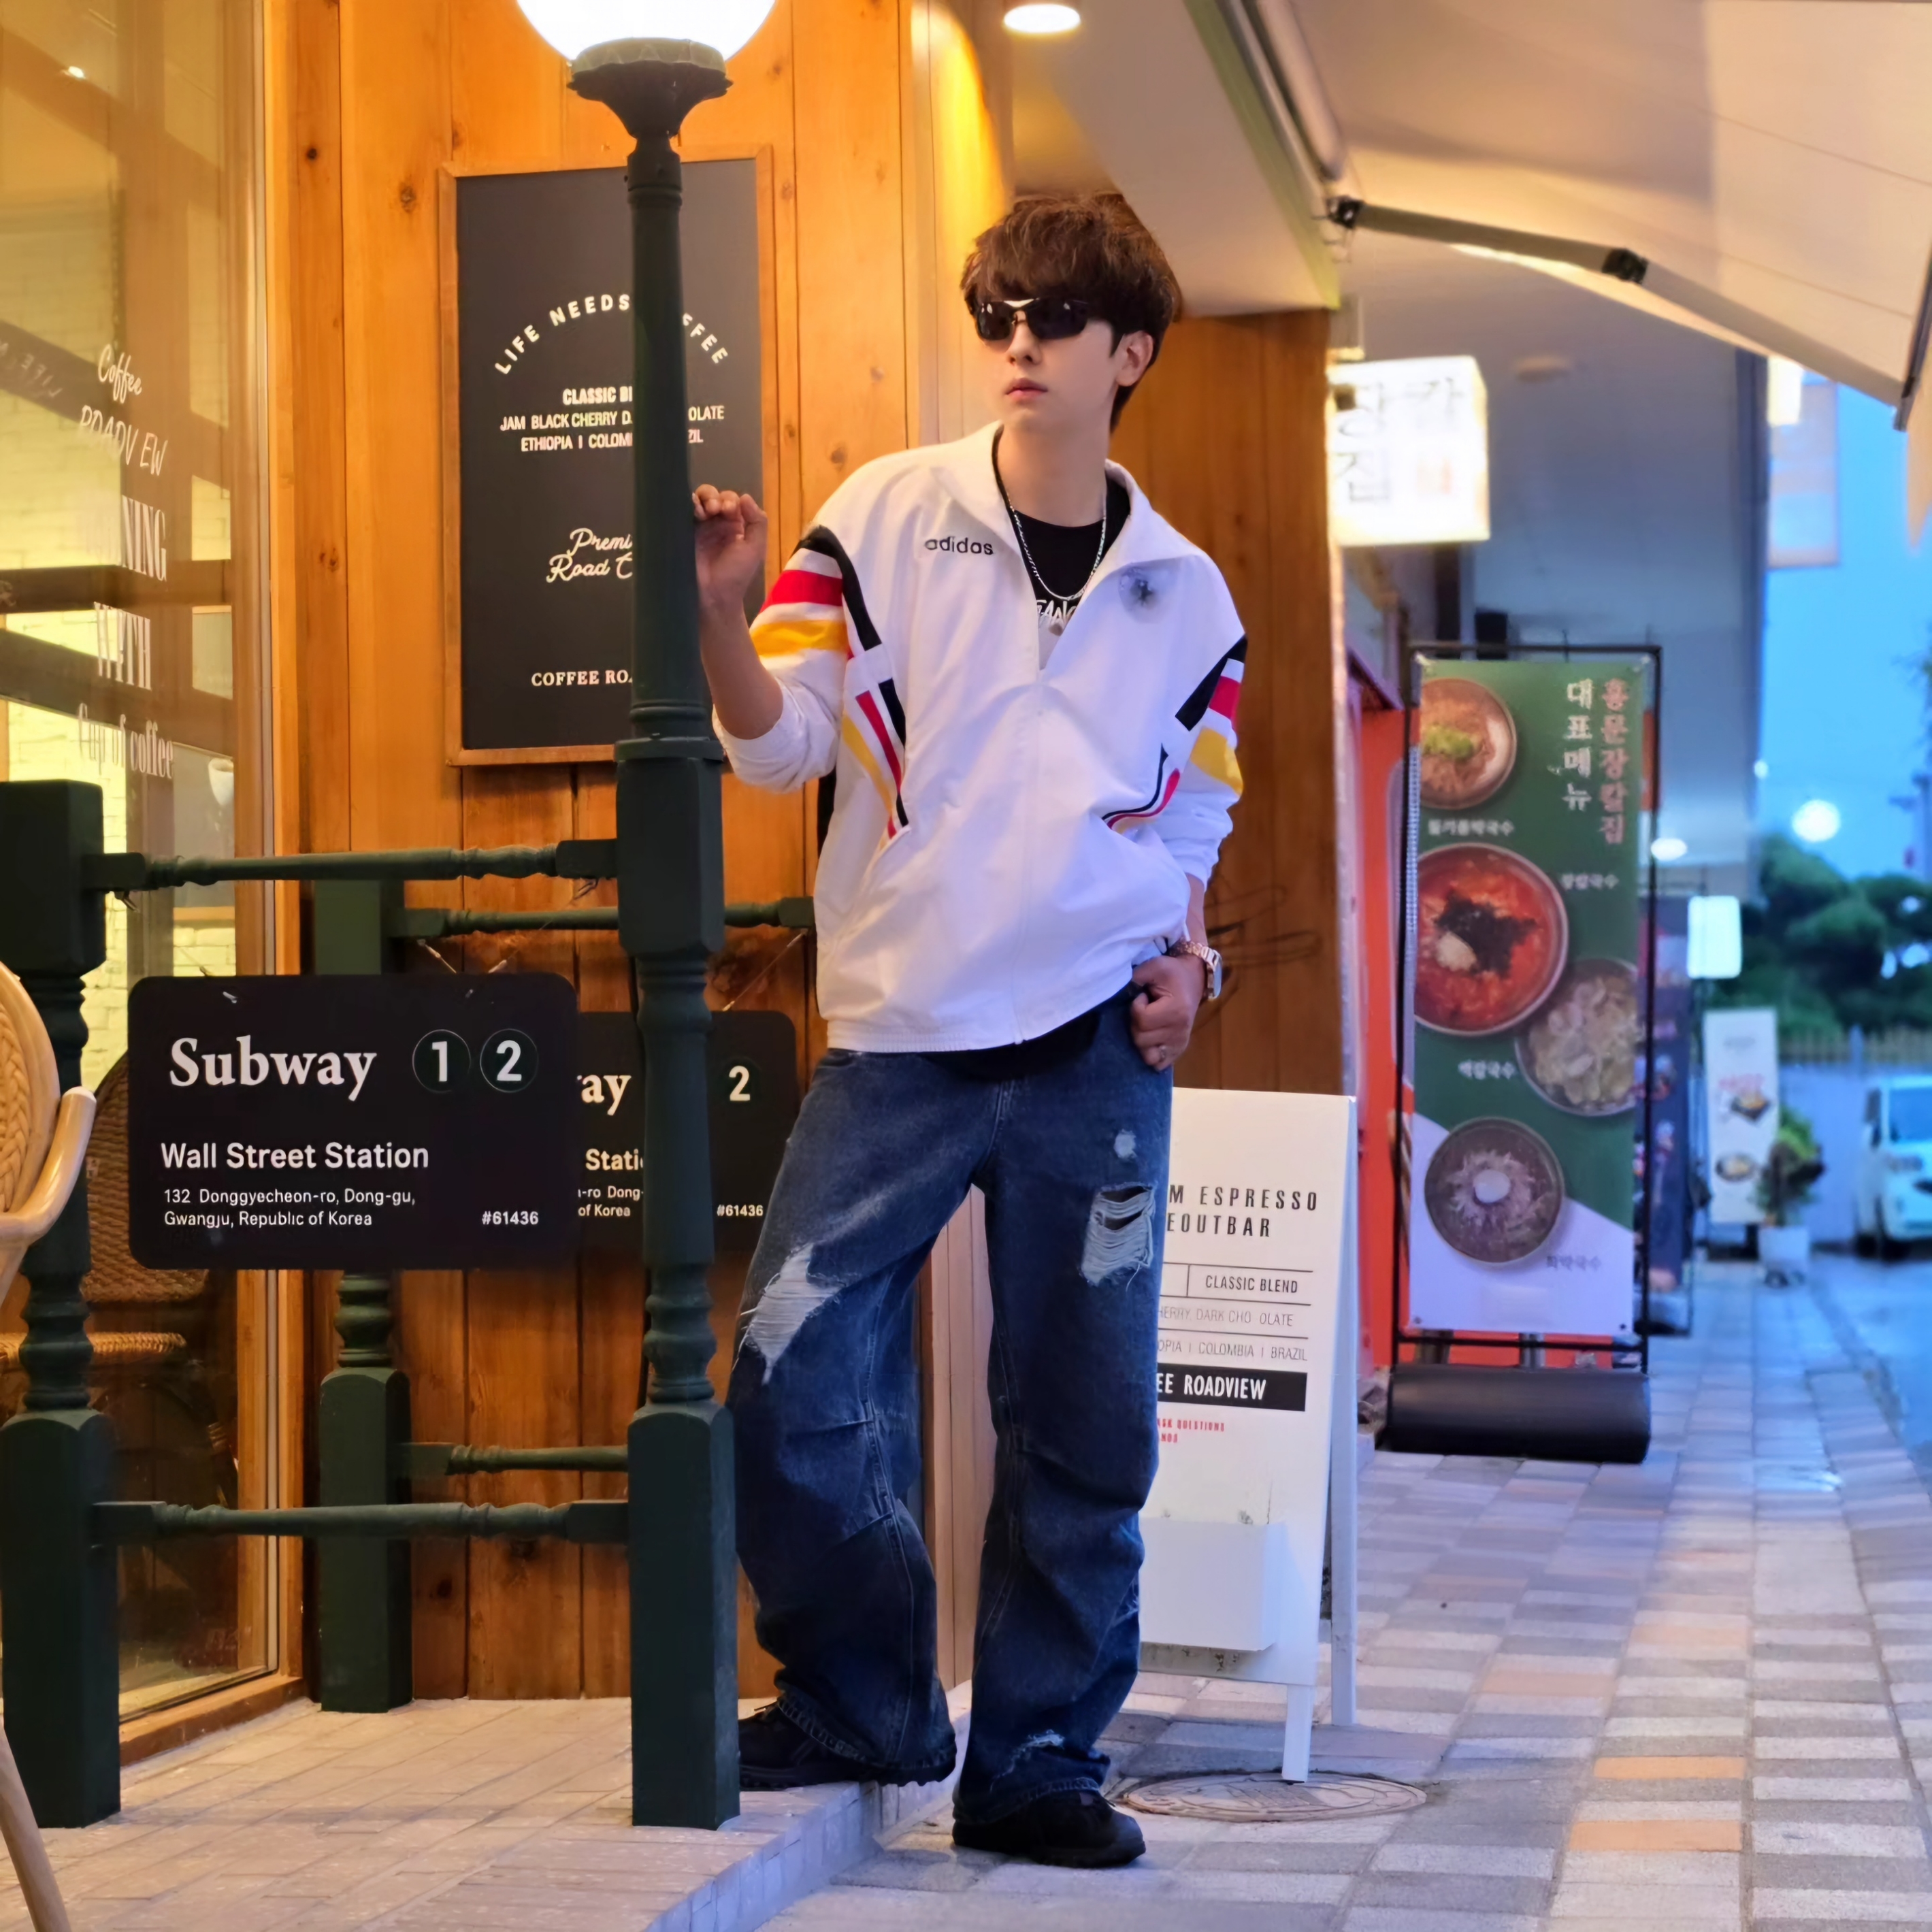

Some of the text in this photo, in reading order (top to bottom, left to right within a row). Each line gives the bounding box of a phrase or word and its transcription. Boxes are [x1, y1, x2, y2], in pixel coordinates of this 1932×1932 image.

[495, 294, 728, 374] LIFE NEEDS FEE
[98, 343, 142, 404] Coffee
[563, 387, 616, 406] CLASSIC
[500, 414, 525, 431] JAM
[531, 412, 570, 429] BLACK
[572, 411, 617, 428] CHERRY
[689, 406, 725, 421] OLATE
[521, 436, 573, 452] ETHIOPIA
[589, 433, 633, 449] COLOM
[688, 429, 704, 443] ZIL
[120, 495, 167, 582] NING
[567, 527, 633, 557] Premi
[924, 536, 994, 555] adidas
[546, 553, 610, 583] Road
[93, 601, 152, 691] WITH
[531, 670, 633, 687] COFFEE RO
[130, 719, 174, 780] coffee
[169, 1035, 522, 1102] Subway 1 2
[576, 1066, 751, 1116] ay 2
[161, 1142, 429, 1169] Wall Street Station
[164, 1188, 416, 1207] 132 Donggyecheon-ro, Dong-gu,
[608, 1185, 644, 1201] Dong-
[1168, 1184, 1318, 1211] M ESPRESSO
[164, 1211, 372, 1230] Gwangju, Republic of Korea
[482, 1211, 539, 1226] #61436
[578, 1204, 631, 1217] of Korea
[717, 1204, 764, 1217] #61436
[1166, 1211, 1272, 1239] EOUTBAR
[1205, 1275, 1298, 1294] CLASSIC BLEND
[1196, 1308, 1225, 1322] DARK
[1158, 1339, 1182, 1353] OPIA
[1198, 1341, 1254, 1358] COLOMBIA
[1271, 1346, 1308, 1362] BRAZIL
[1157, 1372, 1267, 1401] EE ROADVIEW
